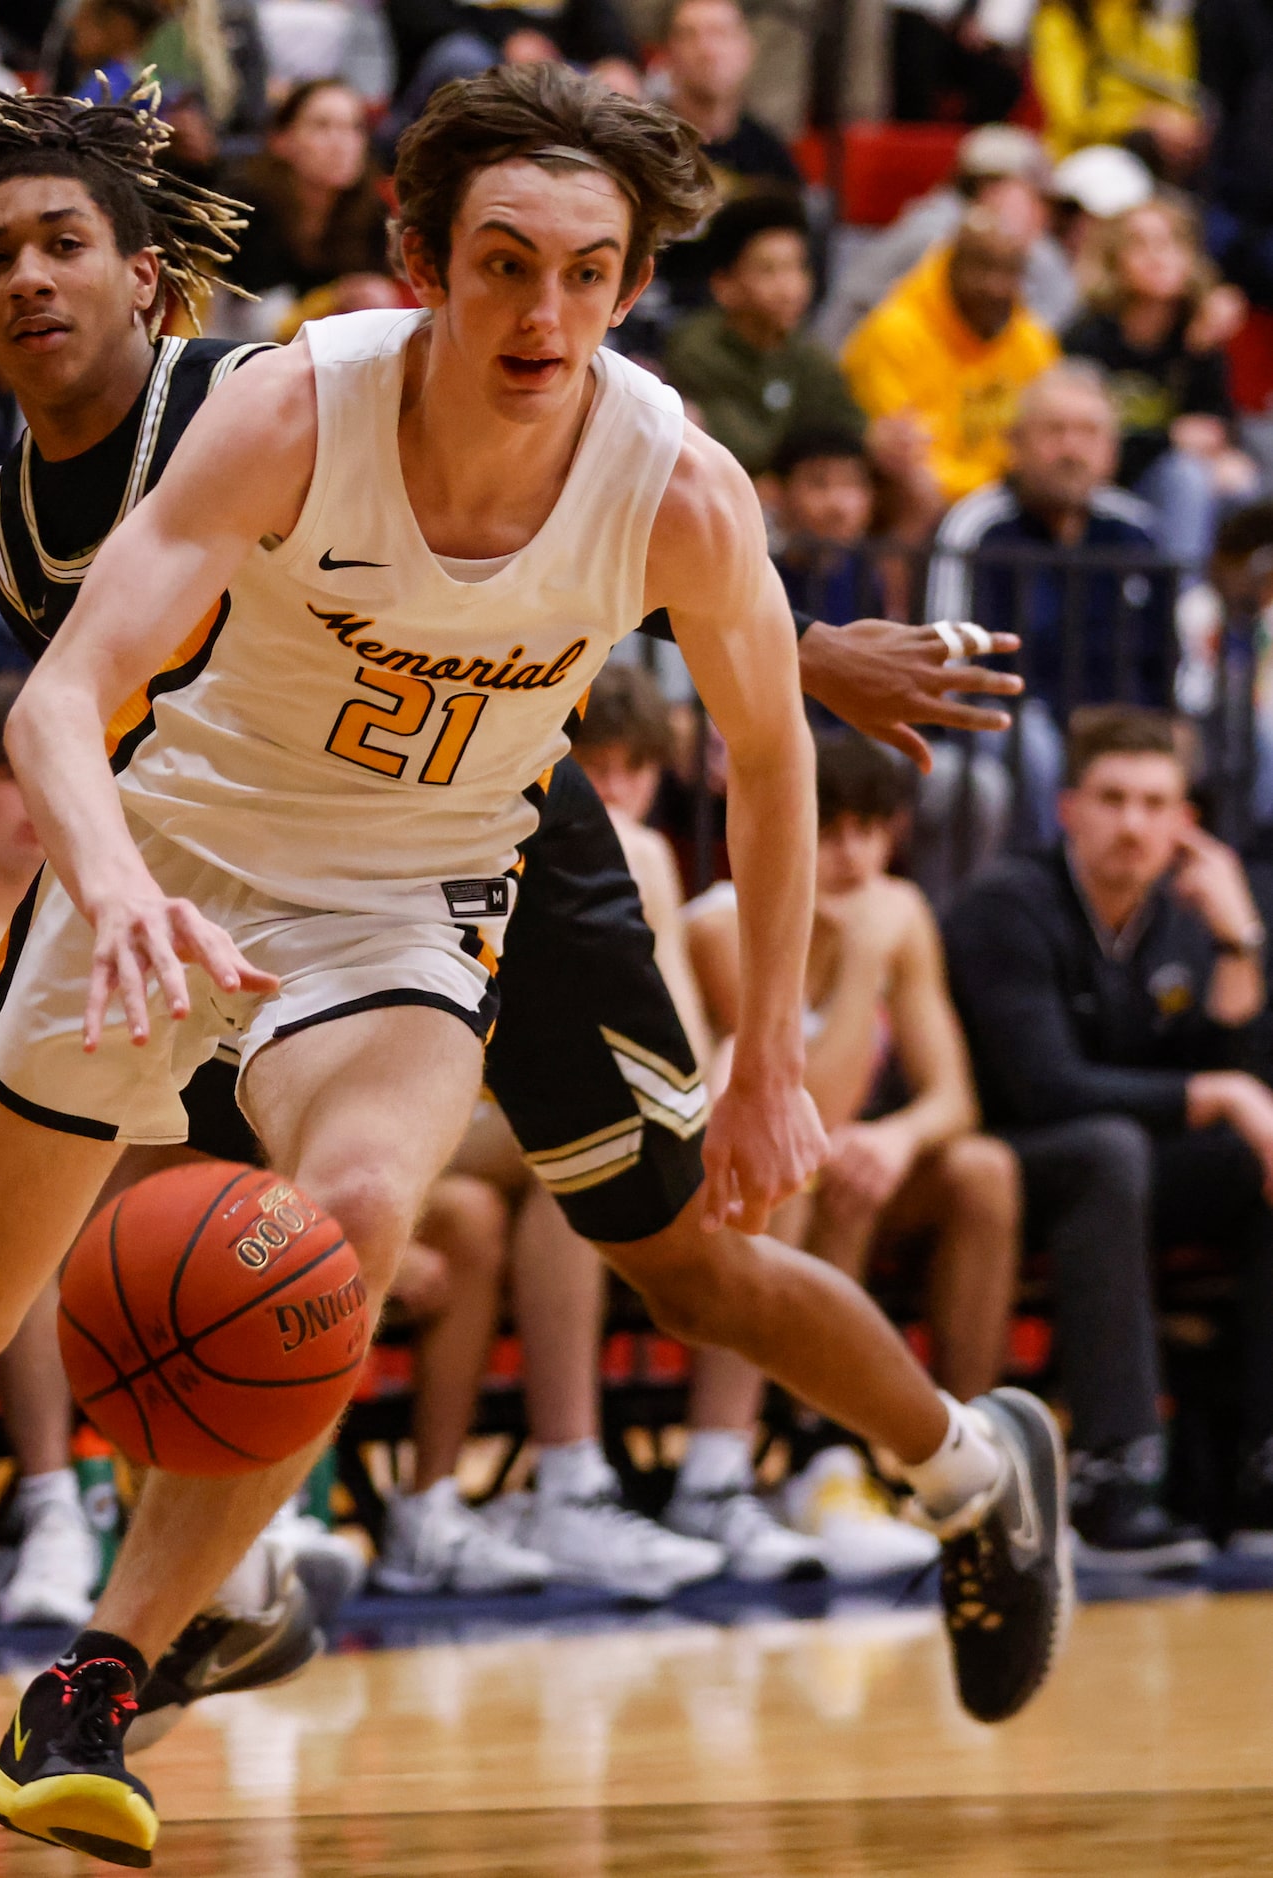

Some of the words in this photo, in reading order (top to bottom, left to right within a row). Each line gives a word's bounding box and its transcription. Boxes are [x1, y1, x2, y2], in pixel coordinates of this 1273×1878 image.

[306, 600, 589, 691] Memorial
[324, 666, 489, 785] 21
[492, 890, 503, 905] M
[235, 1193, 317, 1271] 1000
